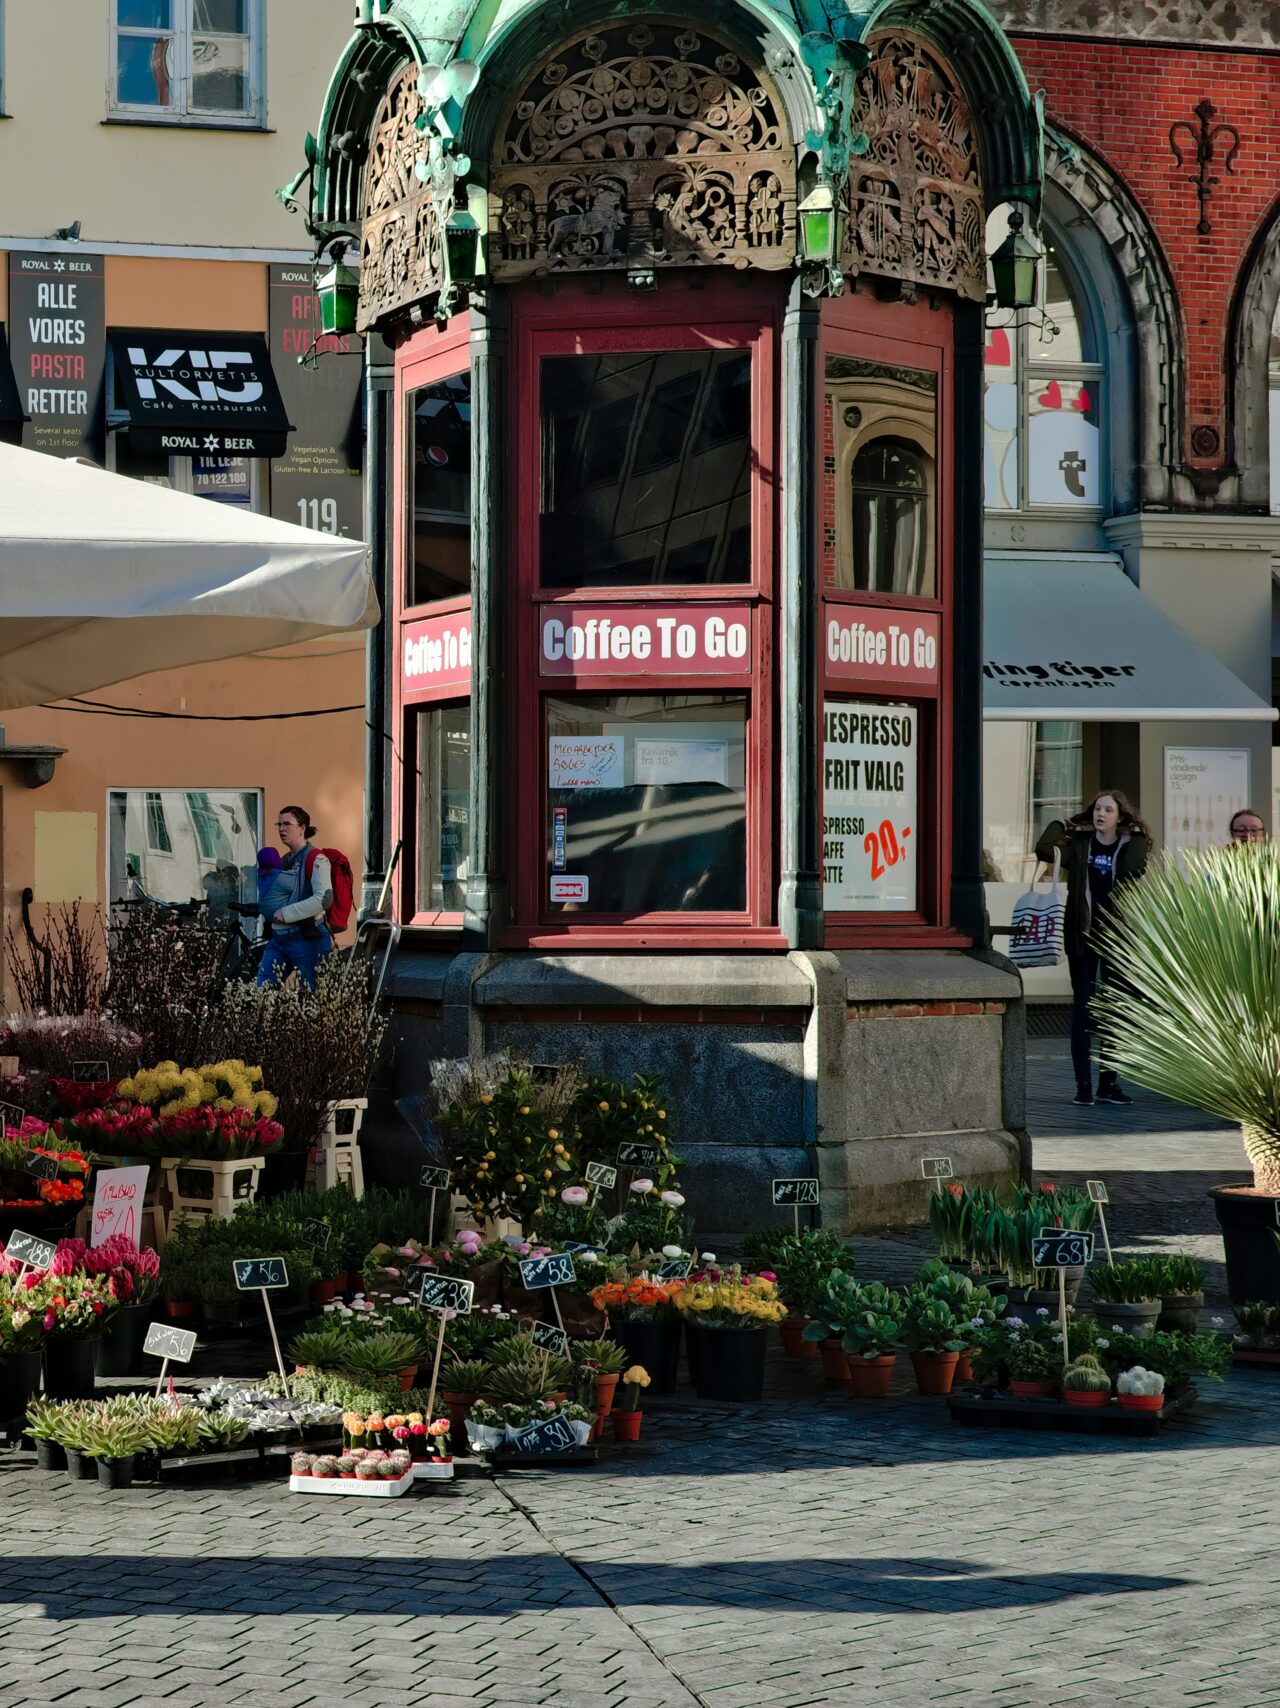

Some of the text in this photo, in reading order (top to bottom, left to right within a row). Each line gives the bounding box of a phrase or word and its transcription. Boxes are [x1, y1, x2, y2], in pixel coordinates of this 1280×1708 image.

[21, 260, 92, 272] ROYAL BEER
[281, 272, 309, 282] ROYAL
[37, 282, 77, 309] ALLE
[28, 317, 85, 345] VORES
[31, 353, 85, 379] PASTA
[133, 368, 258, 381] KULTORVET15
[28, 388, 88, 414] RETTER
[142, 400, 268, 412] Café Restaurant
[34, 426, 81, 436] Several seats
[48, 438, 60, 446] 1st
[62, 438, 79, 447] floor
[161, 435, 256, 450] ROYAL BEER
[293, 446, 336, 454] Vegetarian &
[199, 456, 216, 468] TIL
[290, 456, 338, 465] Vegan Options
[274, 465, 311, 474] Gluten-free
[320, 467, 360, 475] Lactose-free
[197, 471, 247, 485] 70 122 100
[543, 616, 747, 661] Coffee To Go
[827, 619, 936, 669] Coffee To Go
[404, 634, 442, 677] Coffee
[442, 630, 457, 670] To
[1049, 660, 1136, 680] tiger
[999, 678, 1116, 689] copenhagen
[641, 747, 679, 757] Keramik
[641, 756, 654, 765] fra
[825, 758, 905, 792] FRIT VALG
[1170, 772, 1197, 784] design
[1056, 1241, 1082, 1264] 68
[259, 1260, 280, 1284] 56
[444, 1282, 469, 1312] 38
[167, 1332, 188, 1356] 56
